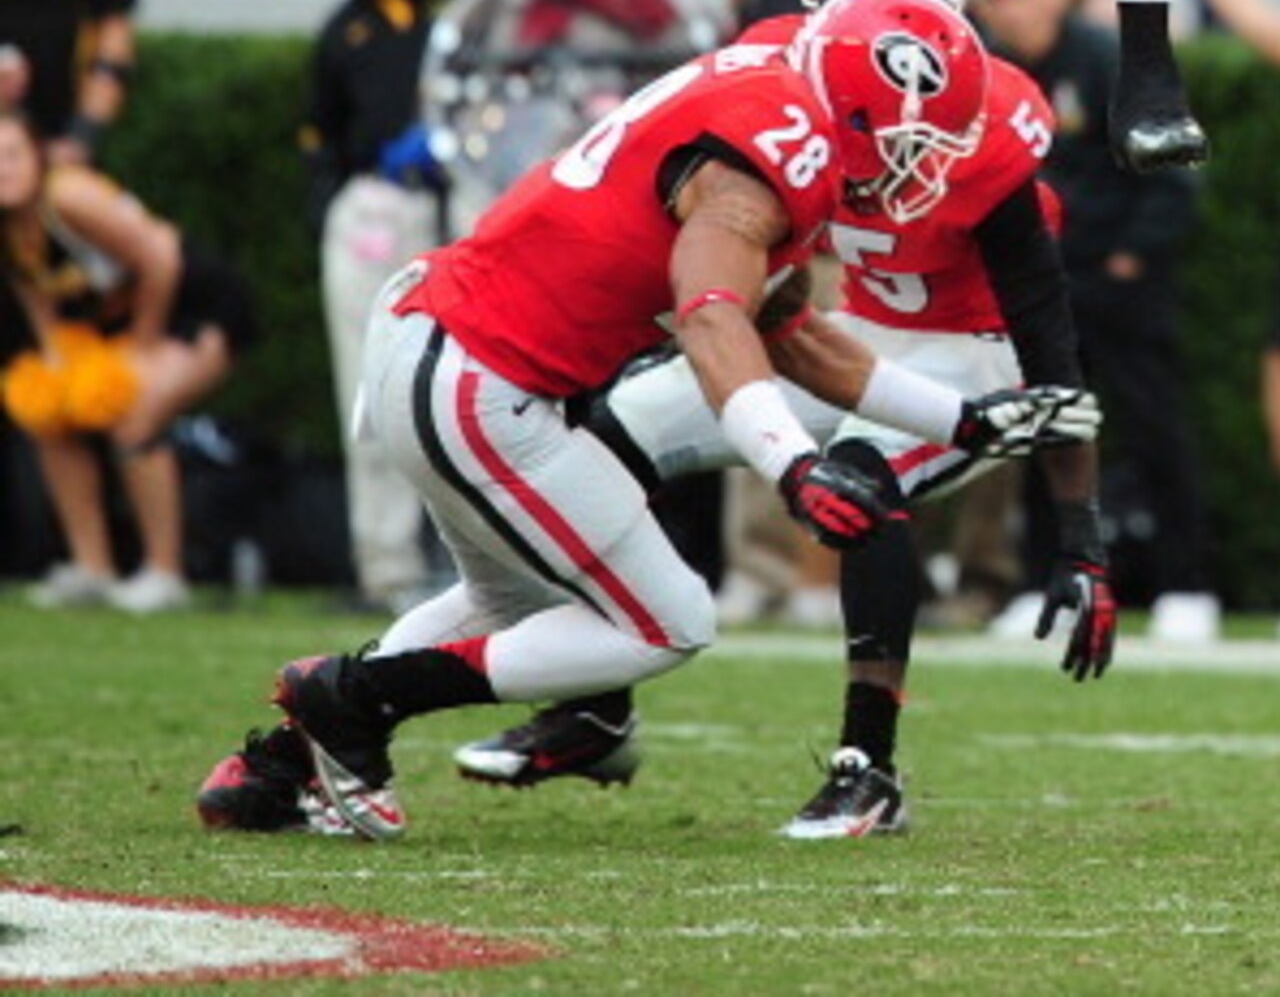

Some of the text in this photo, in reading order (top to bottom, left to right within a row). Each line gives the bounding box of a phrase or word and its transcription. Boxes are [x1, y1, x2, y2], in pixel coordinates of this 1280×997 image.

[753, 104, 830, 188] 28
[1009, 101, 1052, 158] 5
[828, 221, 928, 313] 5
